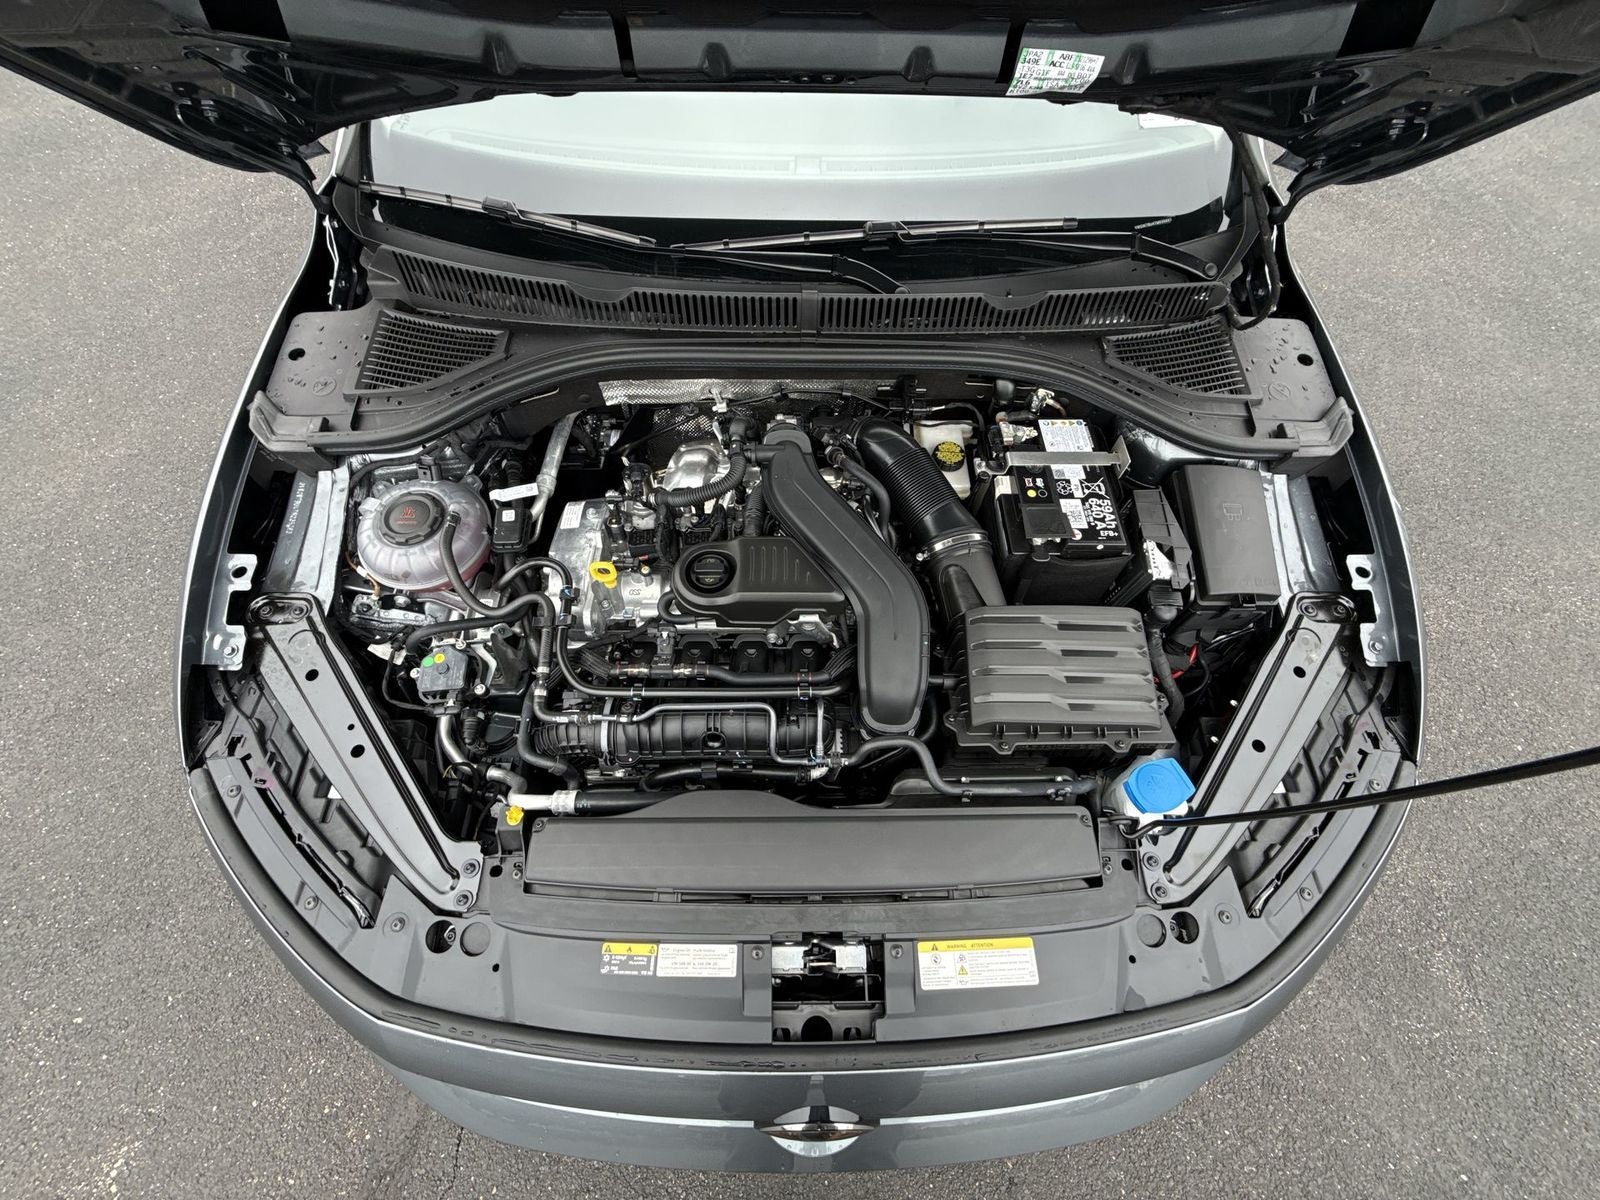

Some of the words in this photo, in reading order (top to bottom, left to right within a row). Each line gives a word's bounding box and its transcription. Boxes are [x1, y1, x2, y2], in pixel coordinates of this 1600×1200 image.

[1088, 498, 1104, 518] 640
[1100, 499, 1118, 529] 59Ah
[1095, 520, 1107, 530] A
